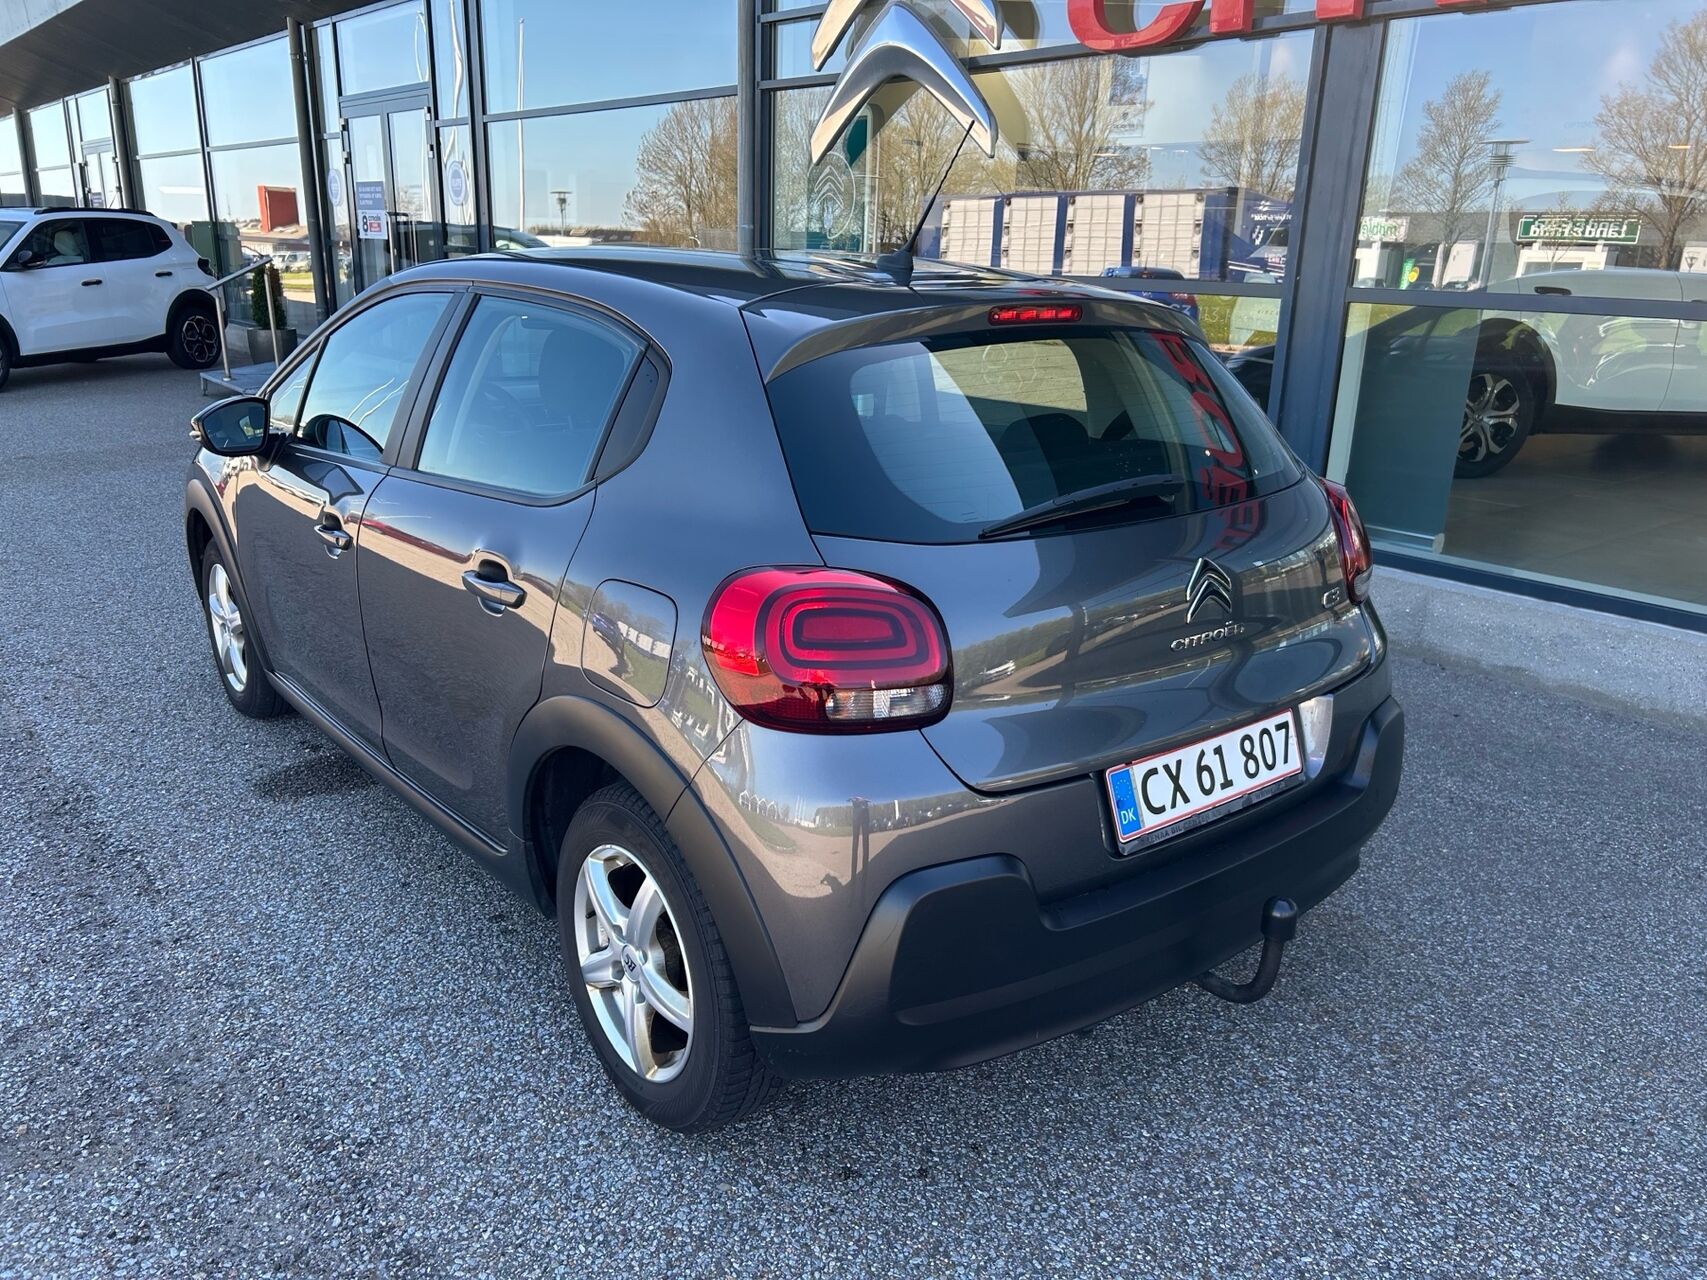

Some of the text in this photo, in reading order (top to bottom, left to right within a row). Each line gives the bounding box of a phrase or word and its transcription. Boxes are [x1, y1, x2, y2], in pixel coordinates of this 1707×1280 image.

[1141, 758, 1191, 815] CX
[1196, 745, 1234, 796] 61
[1239, 720, 1290, 779] 807
[1120, 808, 1137, 825] DK
